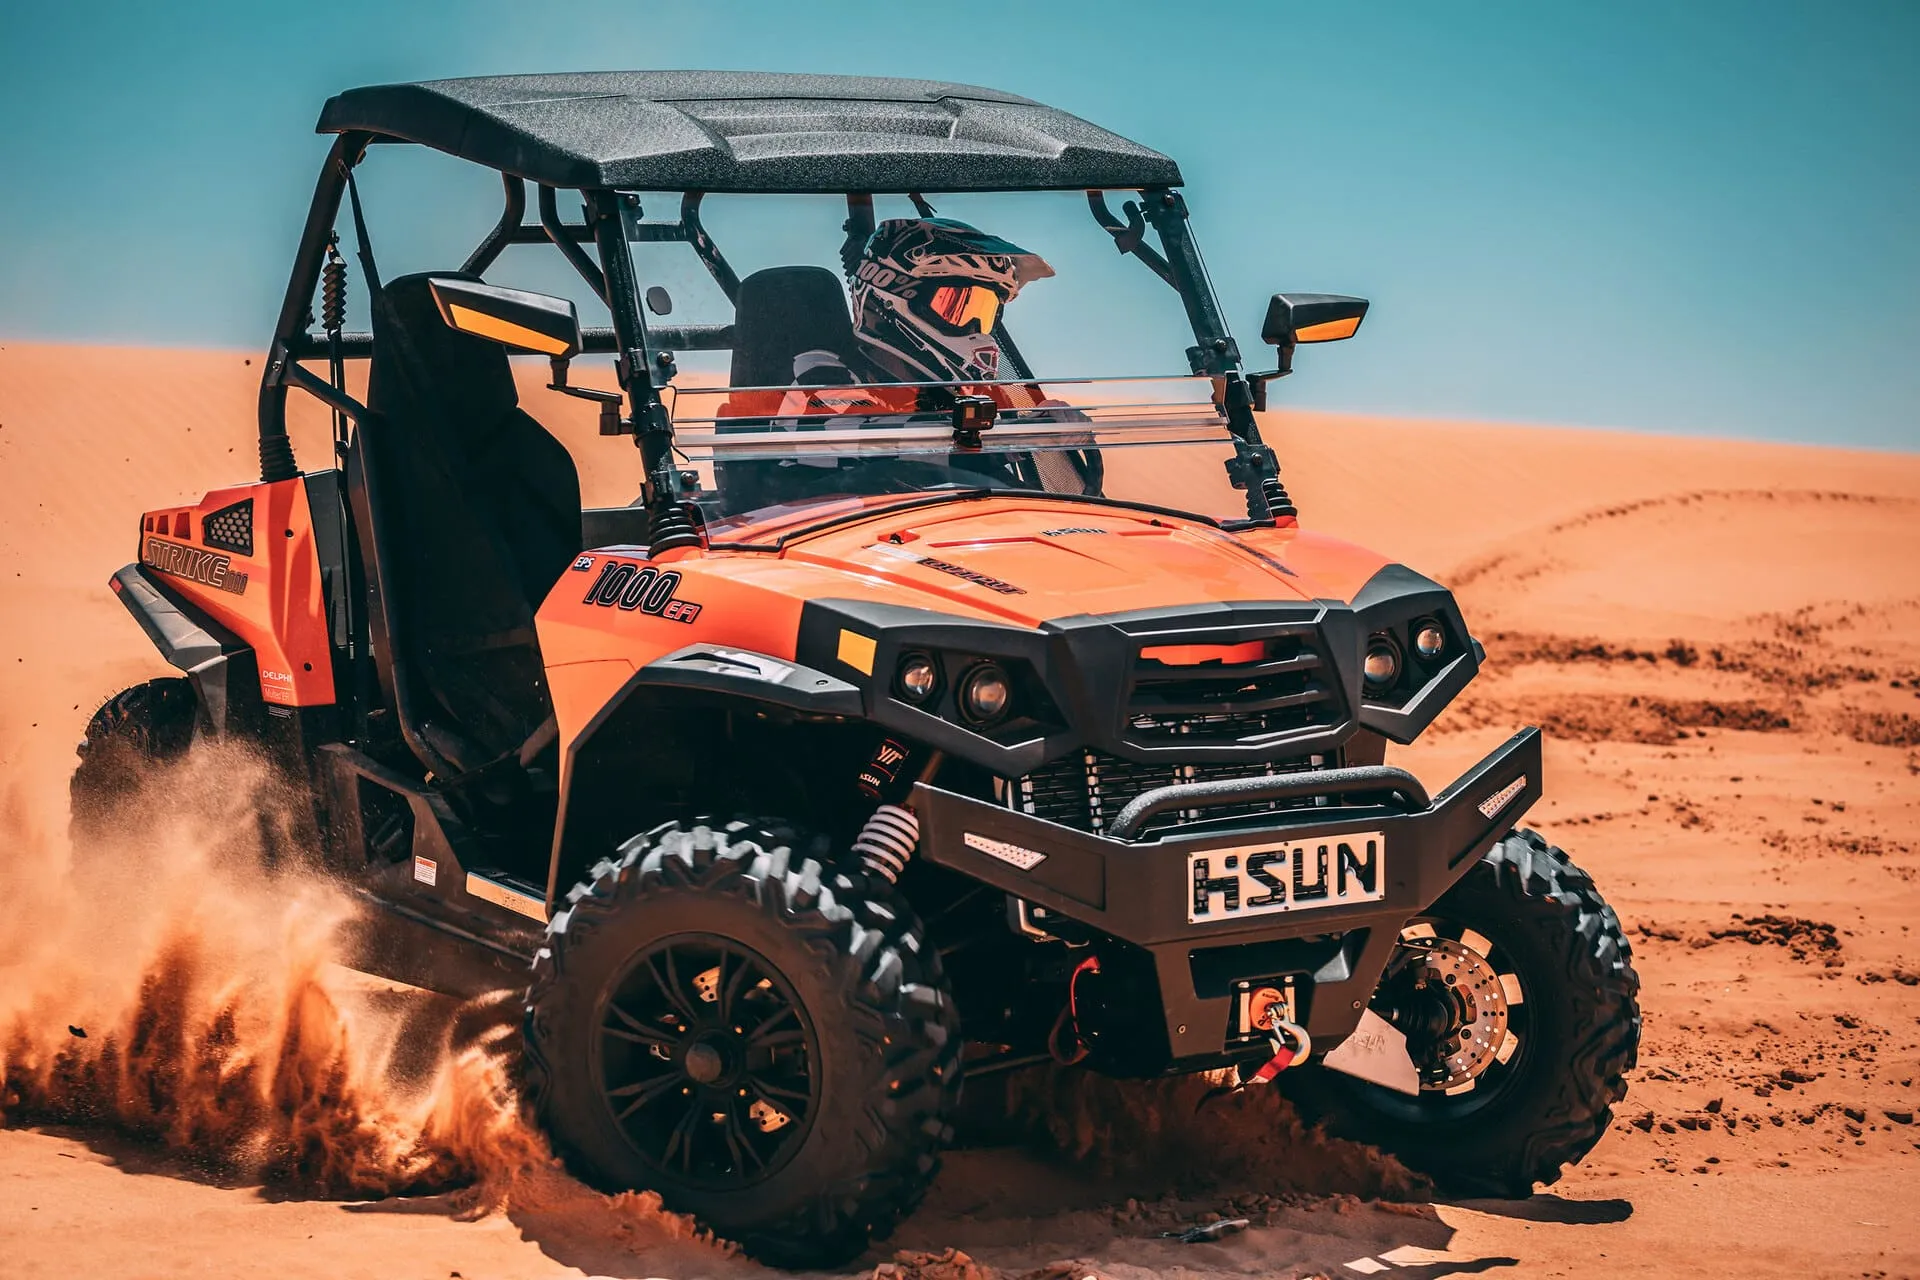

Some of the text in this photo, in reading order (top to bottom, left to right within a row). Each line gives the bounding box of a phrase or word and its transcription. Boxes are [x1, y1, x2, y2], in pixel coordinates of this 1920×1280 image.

[855, 259, 922, 299] 100%
[144, 538, 230, 587] STRIKE
[574, 556, 596, 569] EPS
[585, 562, 698, 624] 1000 EFI
[262, 670, 294, 683] DELPHI
